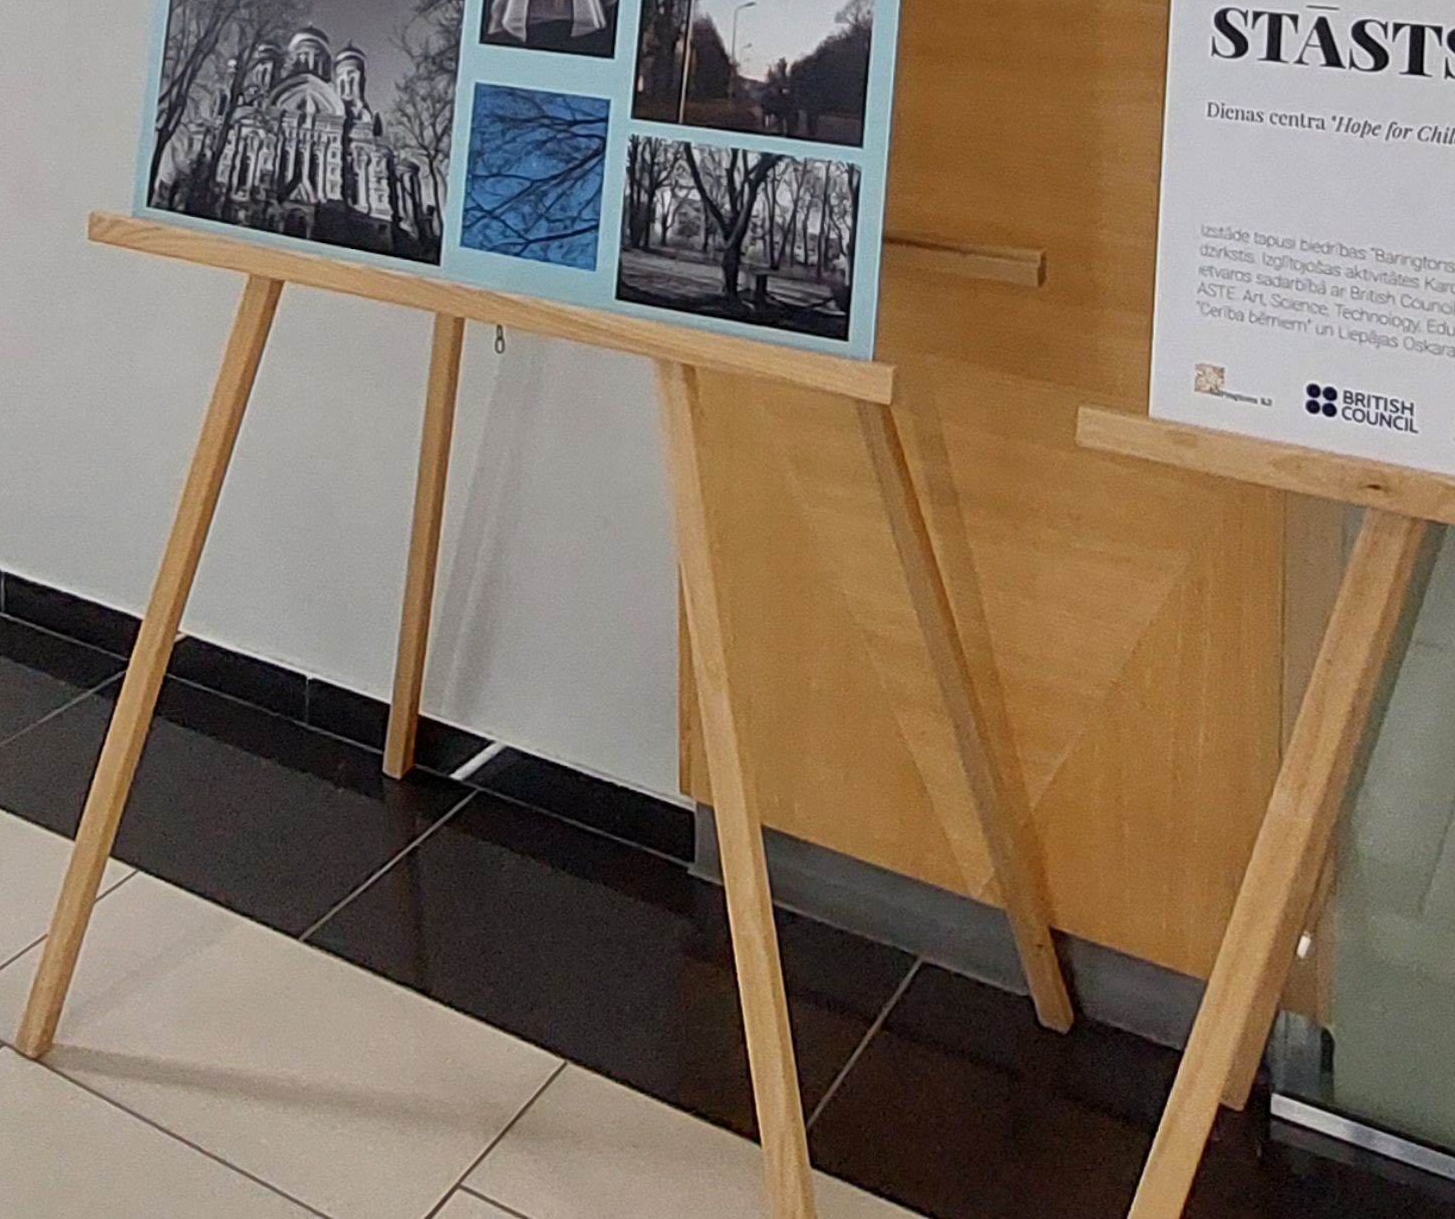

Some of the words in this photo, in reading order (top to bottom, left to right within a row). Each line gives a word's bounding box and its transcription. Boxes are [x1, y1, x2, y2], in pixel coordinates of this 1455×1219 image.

[1207, 101, 1264, 124] Dienas
[1269, 111, 1325, 131] centra
[1386, 120, 1413, 142] for
[1330, 285, 1344, 298] ar
[1350, 286, 1395, 305] British
[1315, 322, 1334, 337] un
[1343, 390, 1414, 417] BRITISH
[1341, 406, 1419, 434] COUNCIL
